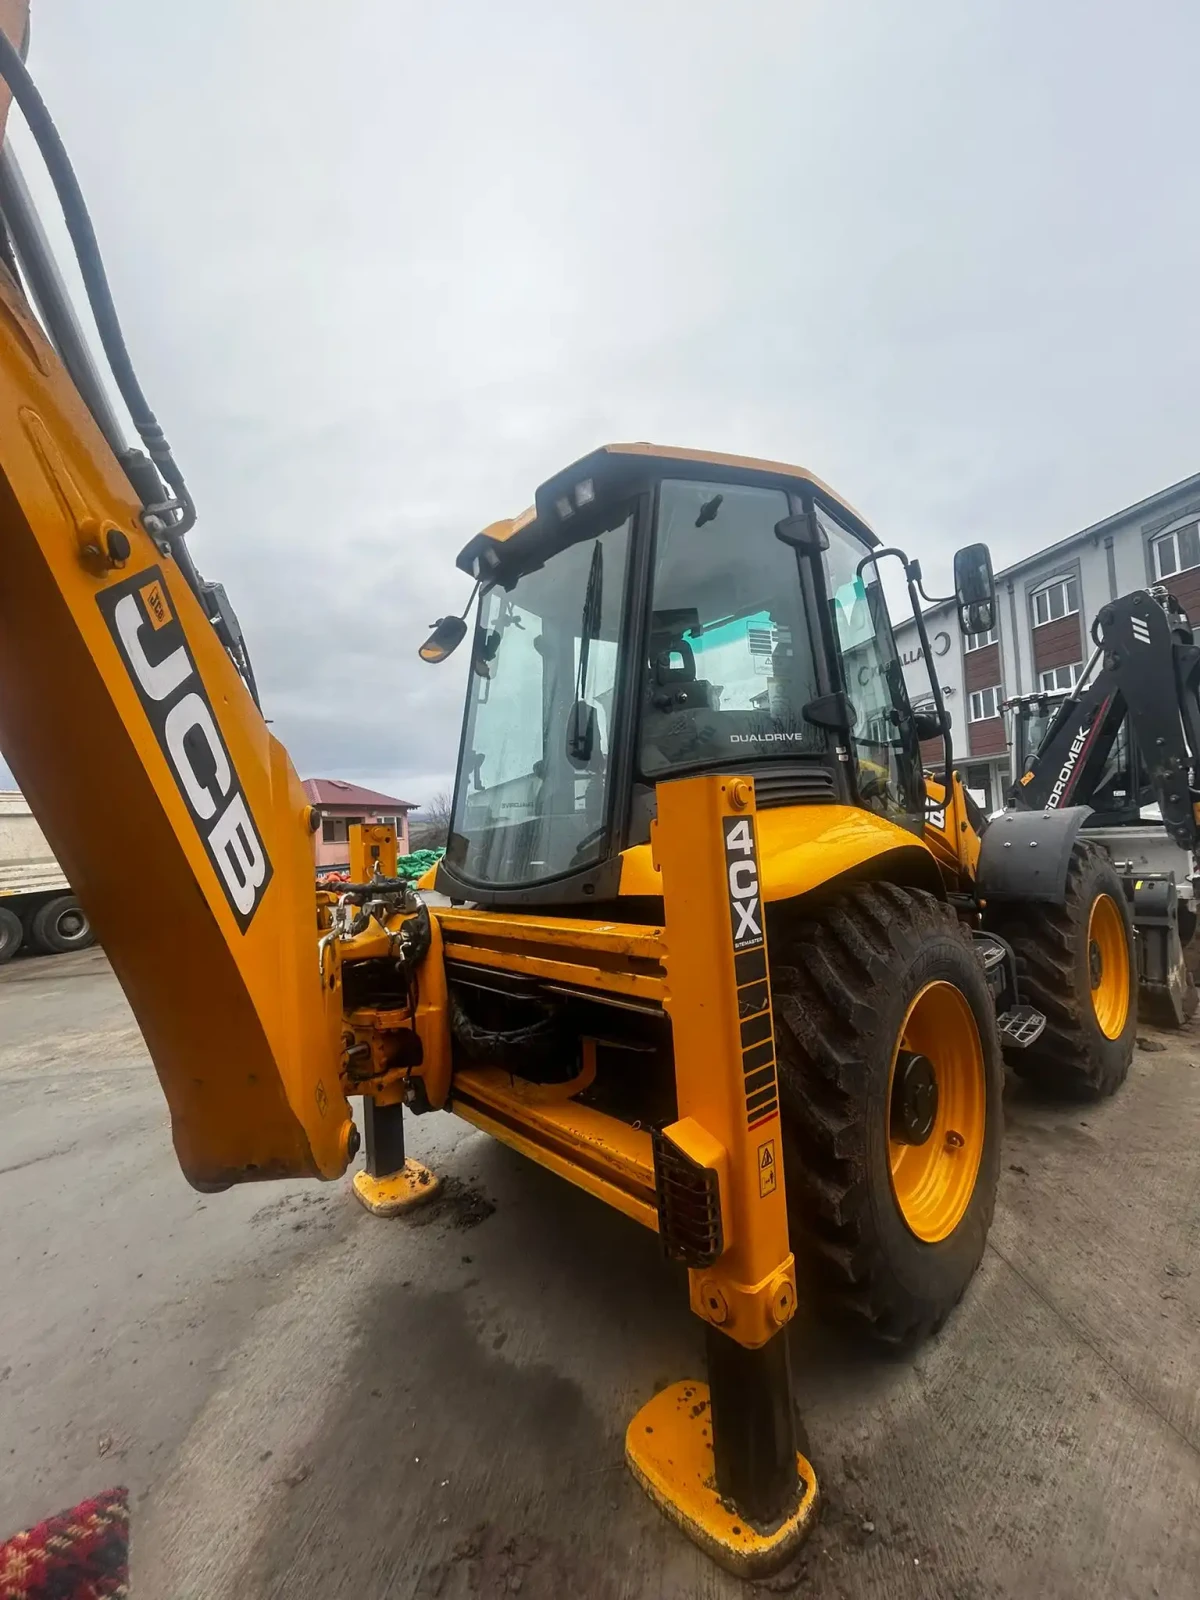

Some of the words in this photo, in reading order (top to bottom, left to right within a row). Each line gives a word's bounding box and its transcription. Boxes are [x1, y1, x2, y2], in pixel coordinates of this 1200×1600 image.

[114, 593, 266, 916] JCB
[730, 732, 803, 743] DUALDRIVE
[726, 820, 762, 940] 4CX
[735, 936, 763, 949] SITEMASTER
